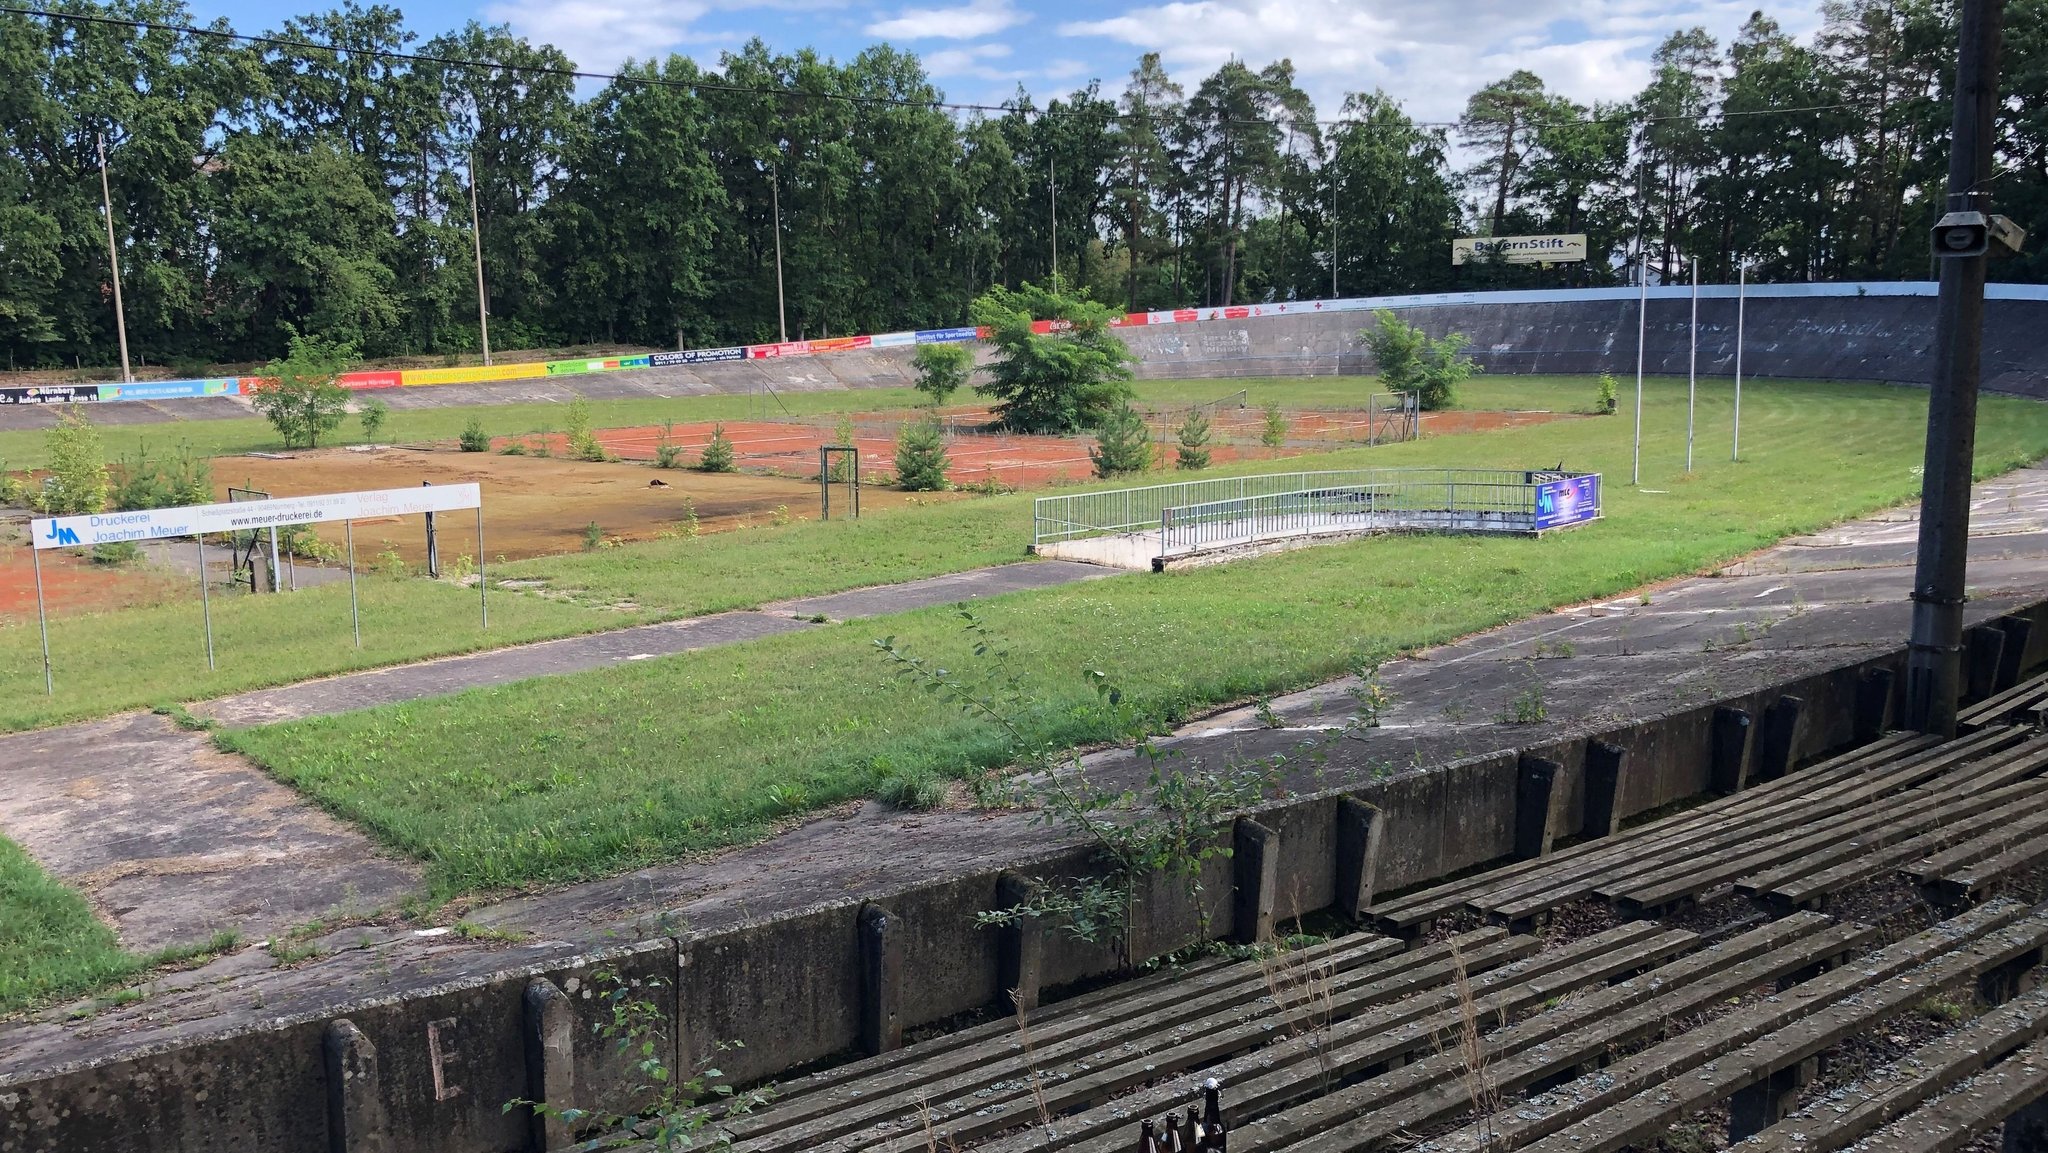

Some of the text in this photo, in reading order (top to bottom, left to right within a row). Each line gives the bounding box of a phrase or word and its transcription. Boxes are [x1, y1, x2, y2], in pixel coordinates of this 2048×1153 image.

[653, 353, 684, 362] COLORS
[697, 348, 742, 358] PROMOTION
[39, 387, 76, 396] Nürnberg
[356, 492, 389, 503] Verlag
[357, 502, 434, 517] Joachim Meuer
[90, 513, 151, 528] Druckerei
[230, 509, 323, 526] www.meuer-druckerei.de
[46, 519, 80, 545] JM
[92, 524, 190, 544] Joachim Meuer
[427, 1016, 463, 1102] E
